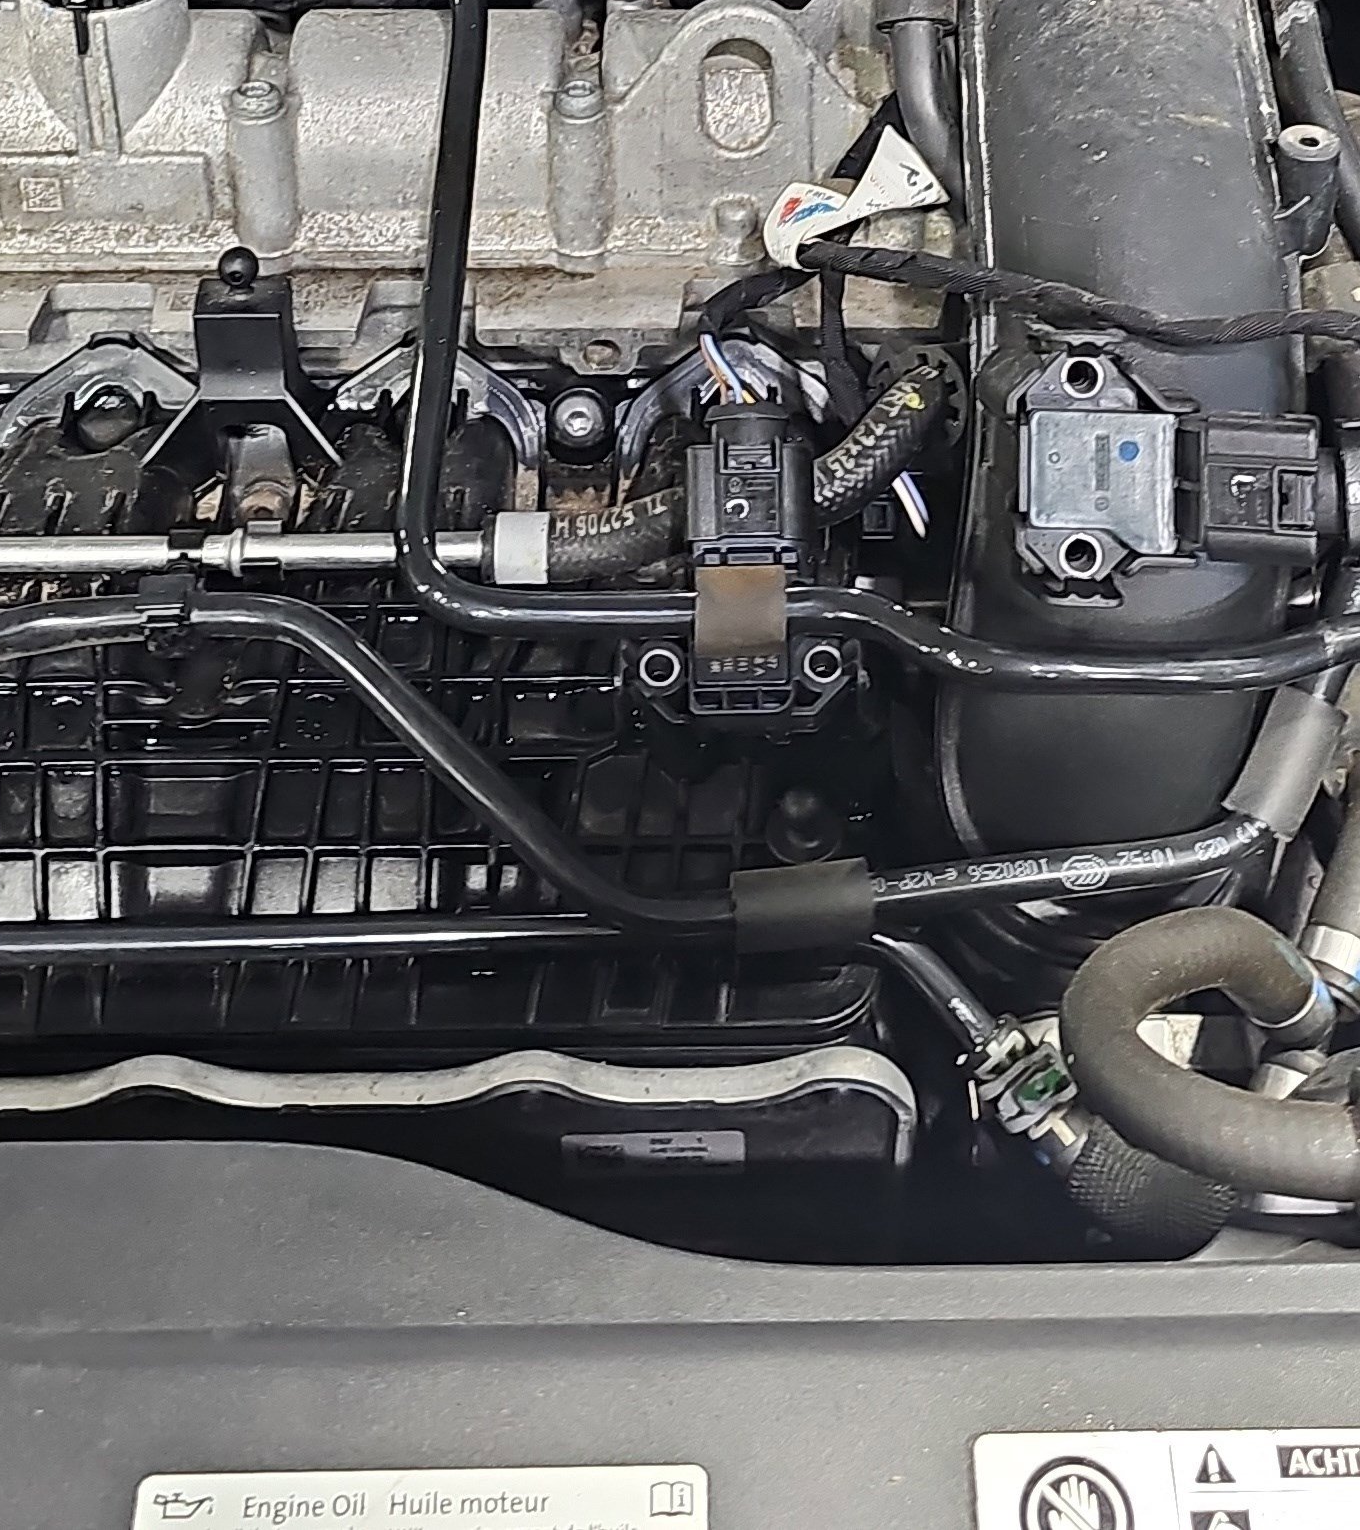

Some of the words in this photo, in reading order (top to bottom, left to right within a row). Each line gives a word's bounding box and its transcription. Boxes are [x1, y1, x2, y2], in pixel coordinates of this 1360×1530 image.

[242, 1495, 327, 1522] Engine
[333, 1491, 366, 1515] Oil
[389, 1490, 453, 1515] Huile
[461, 1492, 550, 1514] moteur
